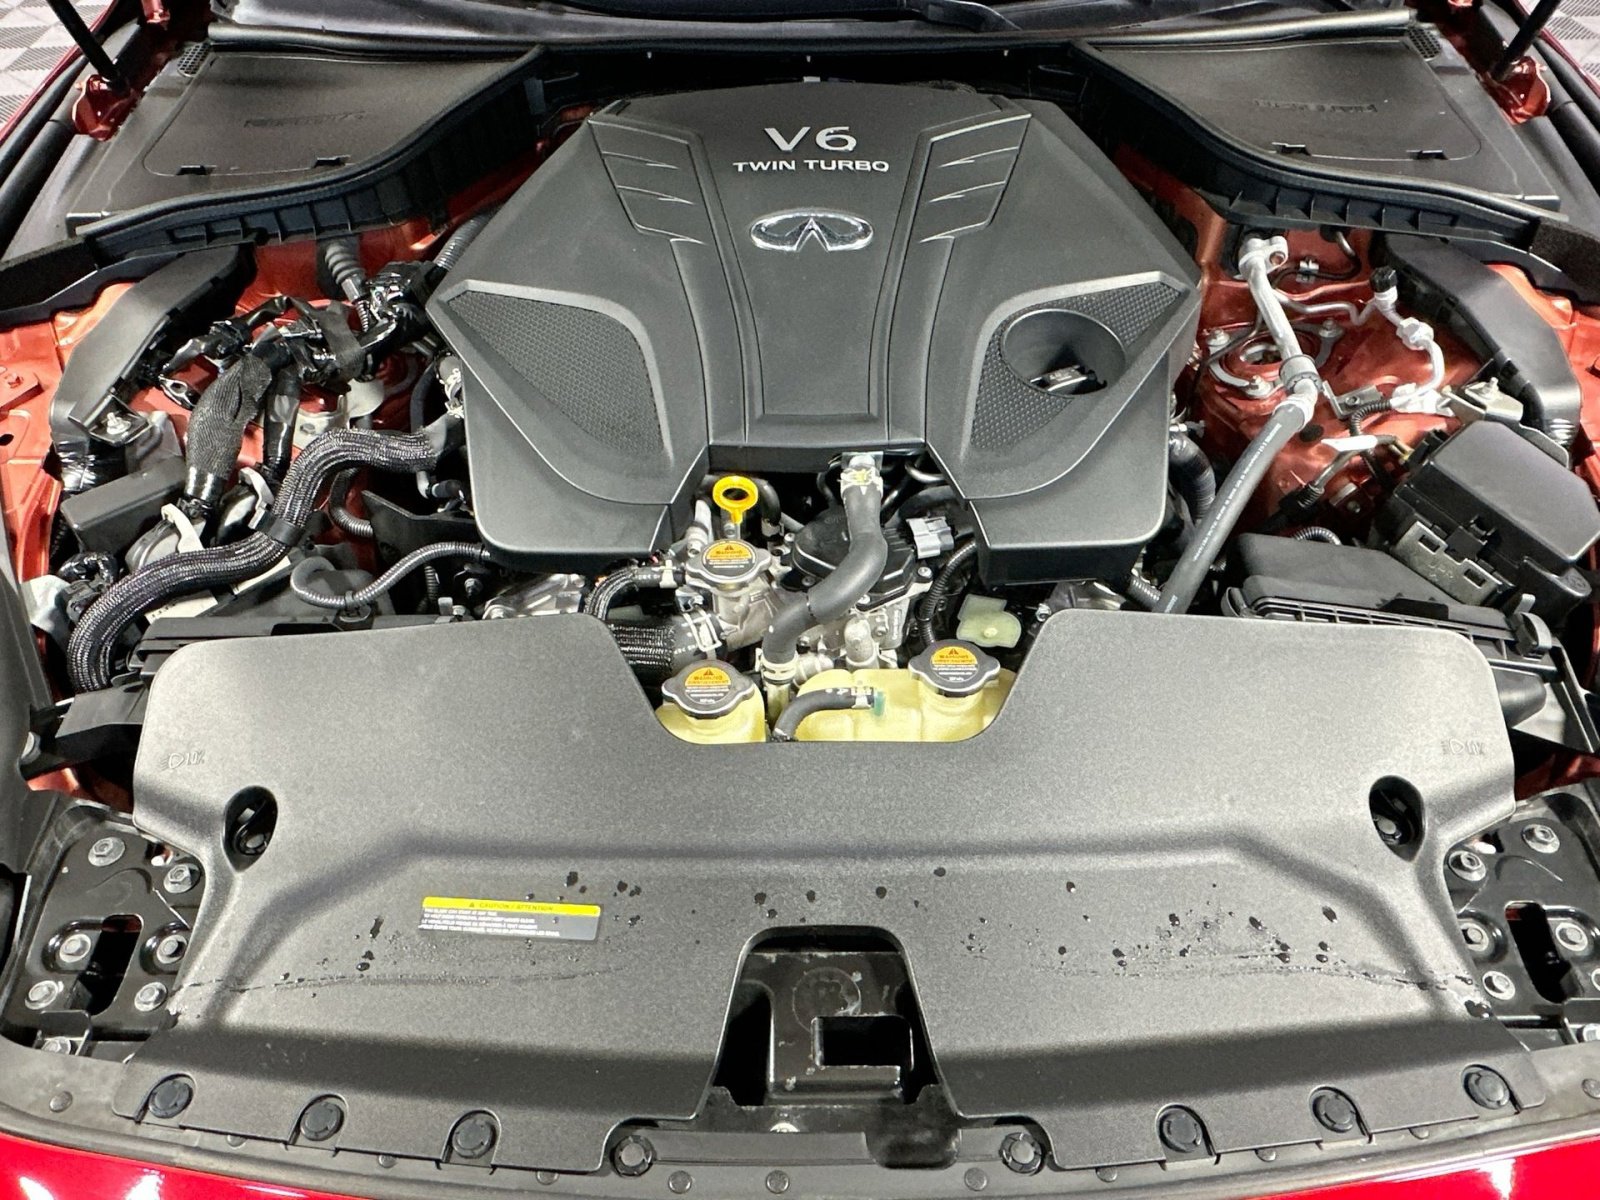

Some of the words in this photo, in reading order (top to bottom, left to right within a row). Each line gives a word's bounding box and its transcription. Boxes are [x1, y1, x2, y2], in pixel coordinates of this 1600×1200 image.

[763, 126, 857, 152] V6
[732, 160, 796, 173] TWIN
[803, 159, 890, 173] TURBO
[479, 901, 510, 909] CAUTION
[516, 903, 554, 911] ATTENTION
